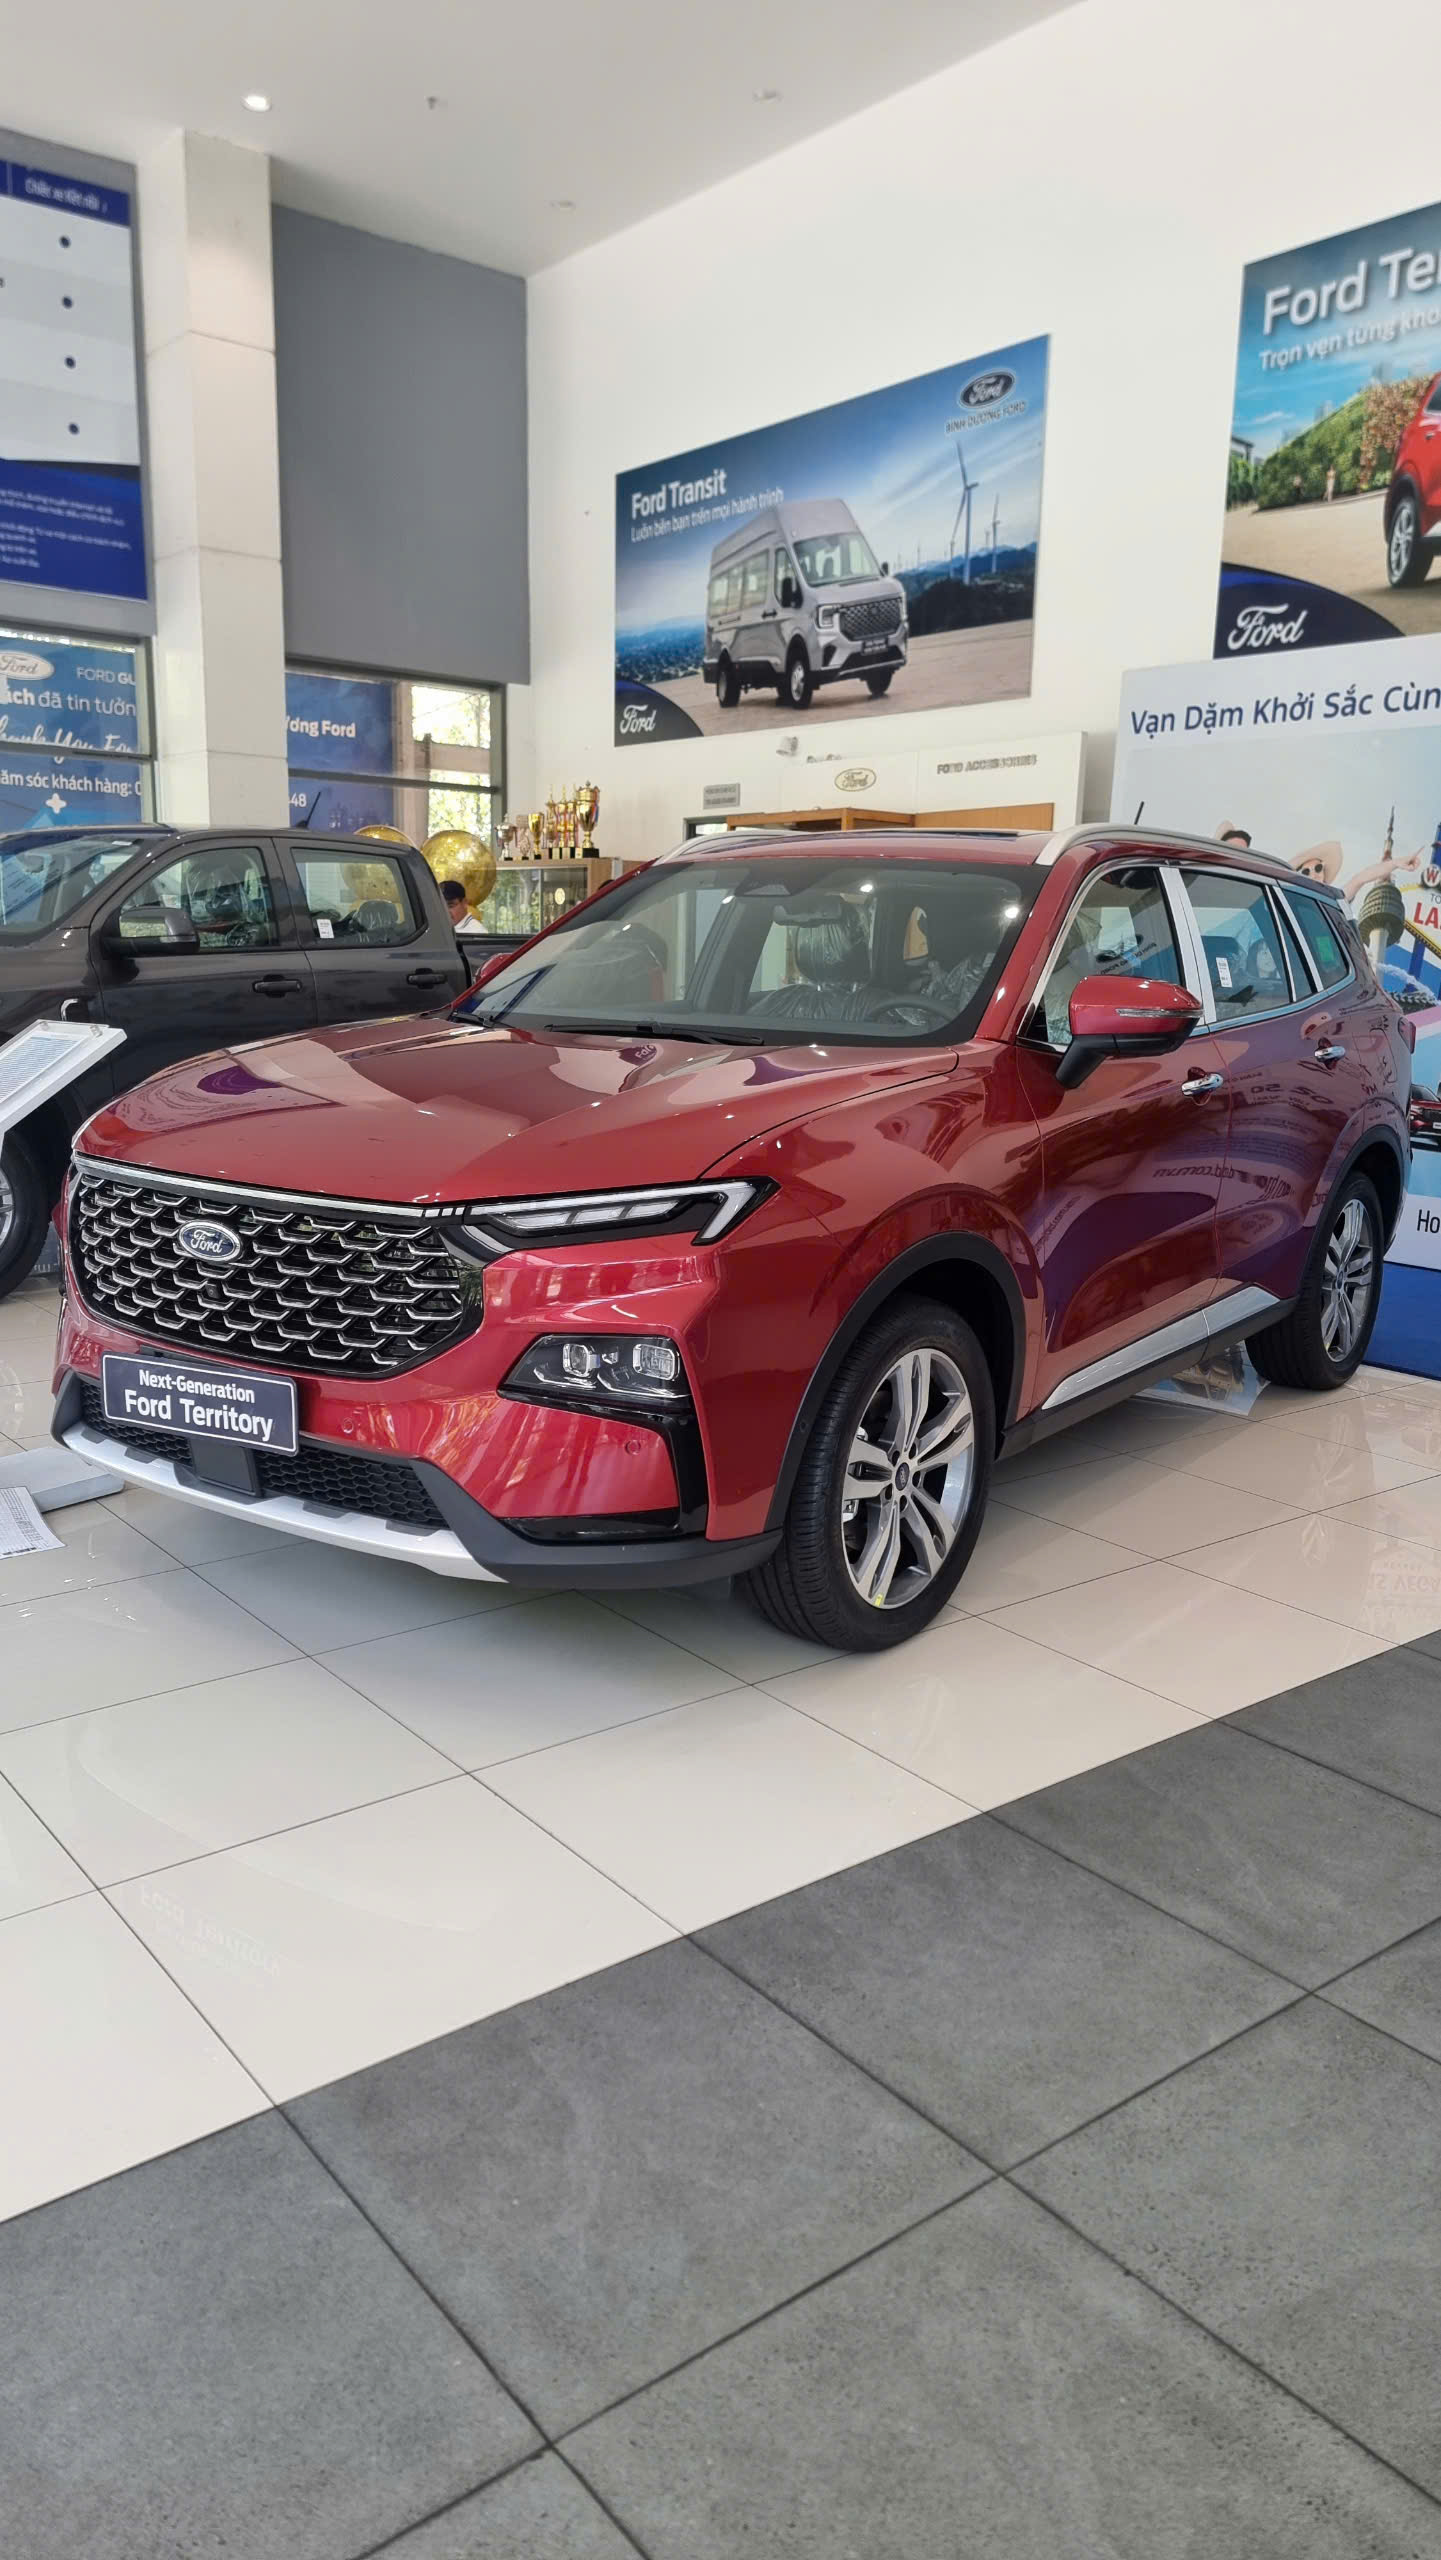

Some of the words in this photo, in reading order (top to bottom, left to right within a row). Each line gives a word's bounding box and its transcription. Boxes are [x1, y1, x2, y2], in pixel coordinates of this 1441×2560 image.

[1263, 260, 1368, 335] Ford
[1259, 344, 1300, 371] Trọn
[1305, 334, 1343, 359] vẹn
[969, 377, 1005, 405] Ford
[632, 485, 666, 520] Ford
[669, 469, 727, 508] Transit
[1228, 603, 1308, 650] Ford
[0, 655, 38, 675] Ford
[77, 667, 115, 683] FORD
[38, 690, 62, 708] đã
[67, 694, 91, 712] tin
[1131, 711, 1175, 739] Vạn
[1184, 702, 1243, 735] Dặm
[1253, 692, 1315, 725] Khởi
[1323, 684, 1373, 718] Sắc
[321, 720, 356, 738] Ford
[620, 704, 657, 733] Ford
[25, 772, 49, 788] sóc
[51, 774, 92, 792] khách
[95, 777, 132, 797] hàng:
[190, 1229, 224, 1253] Ford
[139, 1369, 255, 1404] Next-Generation
[124, 1389, 172, 1420] Ford
[180, 1397, 273, 1442] Territory
